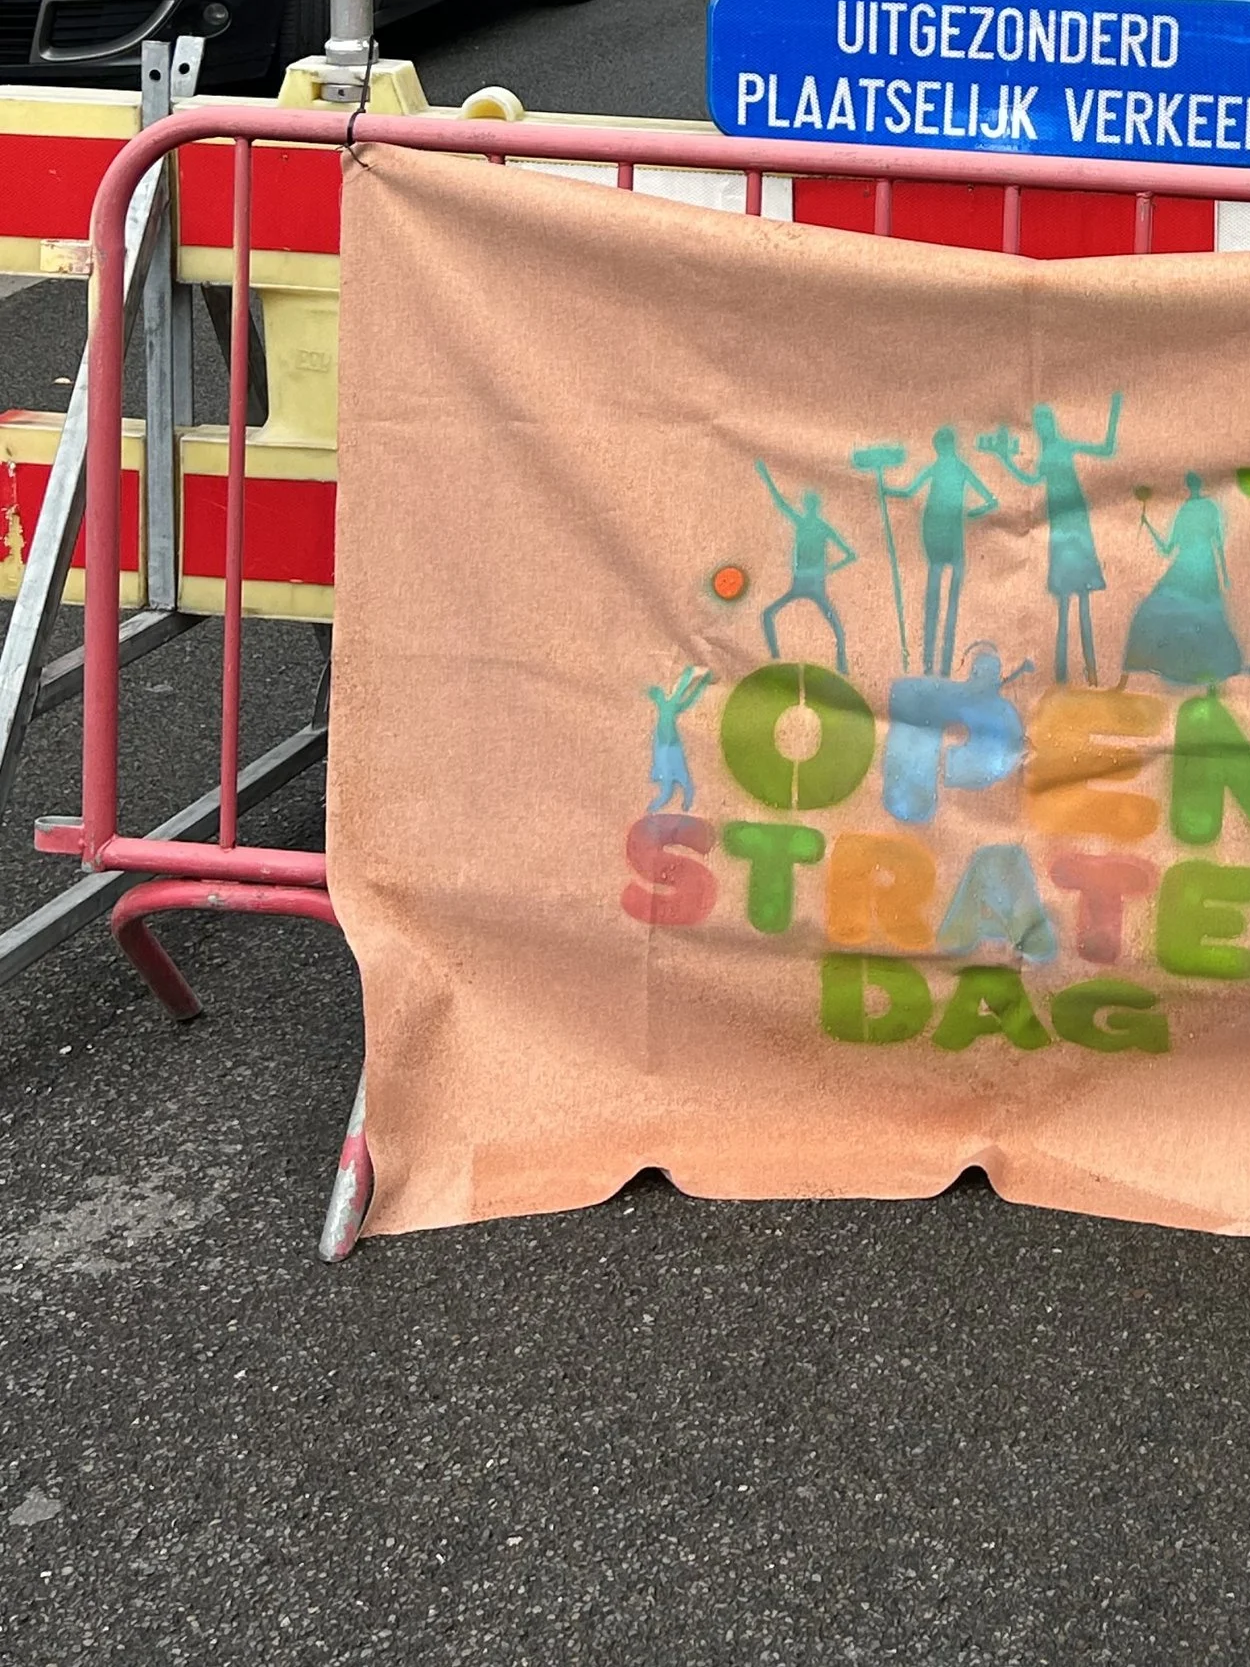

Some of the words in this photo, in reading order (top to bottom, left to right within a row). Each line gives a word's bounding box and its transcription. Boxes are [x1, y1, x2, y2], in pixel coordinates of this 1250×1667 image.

[836, 0, 1179, 70] UITGEZONDERD
[737, 72, 1040, 141] PLAATSELIJK
[819, 951, 1172, 1054] DAG
